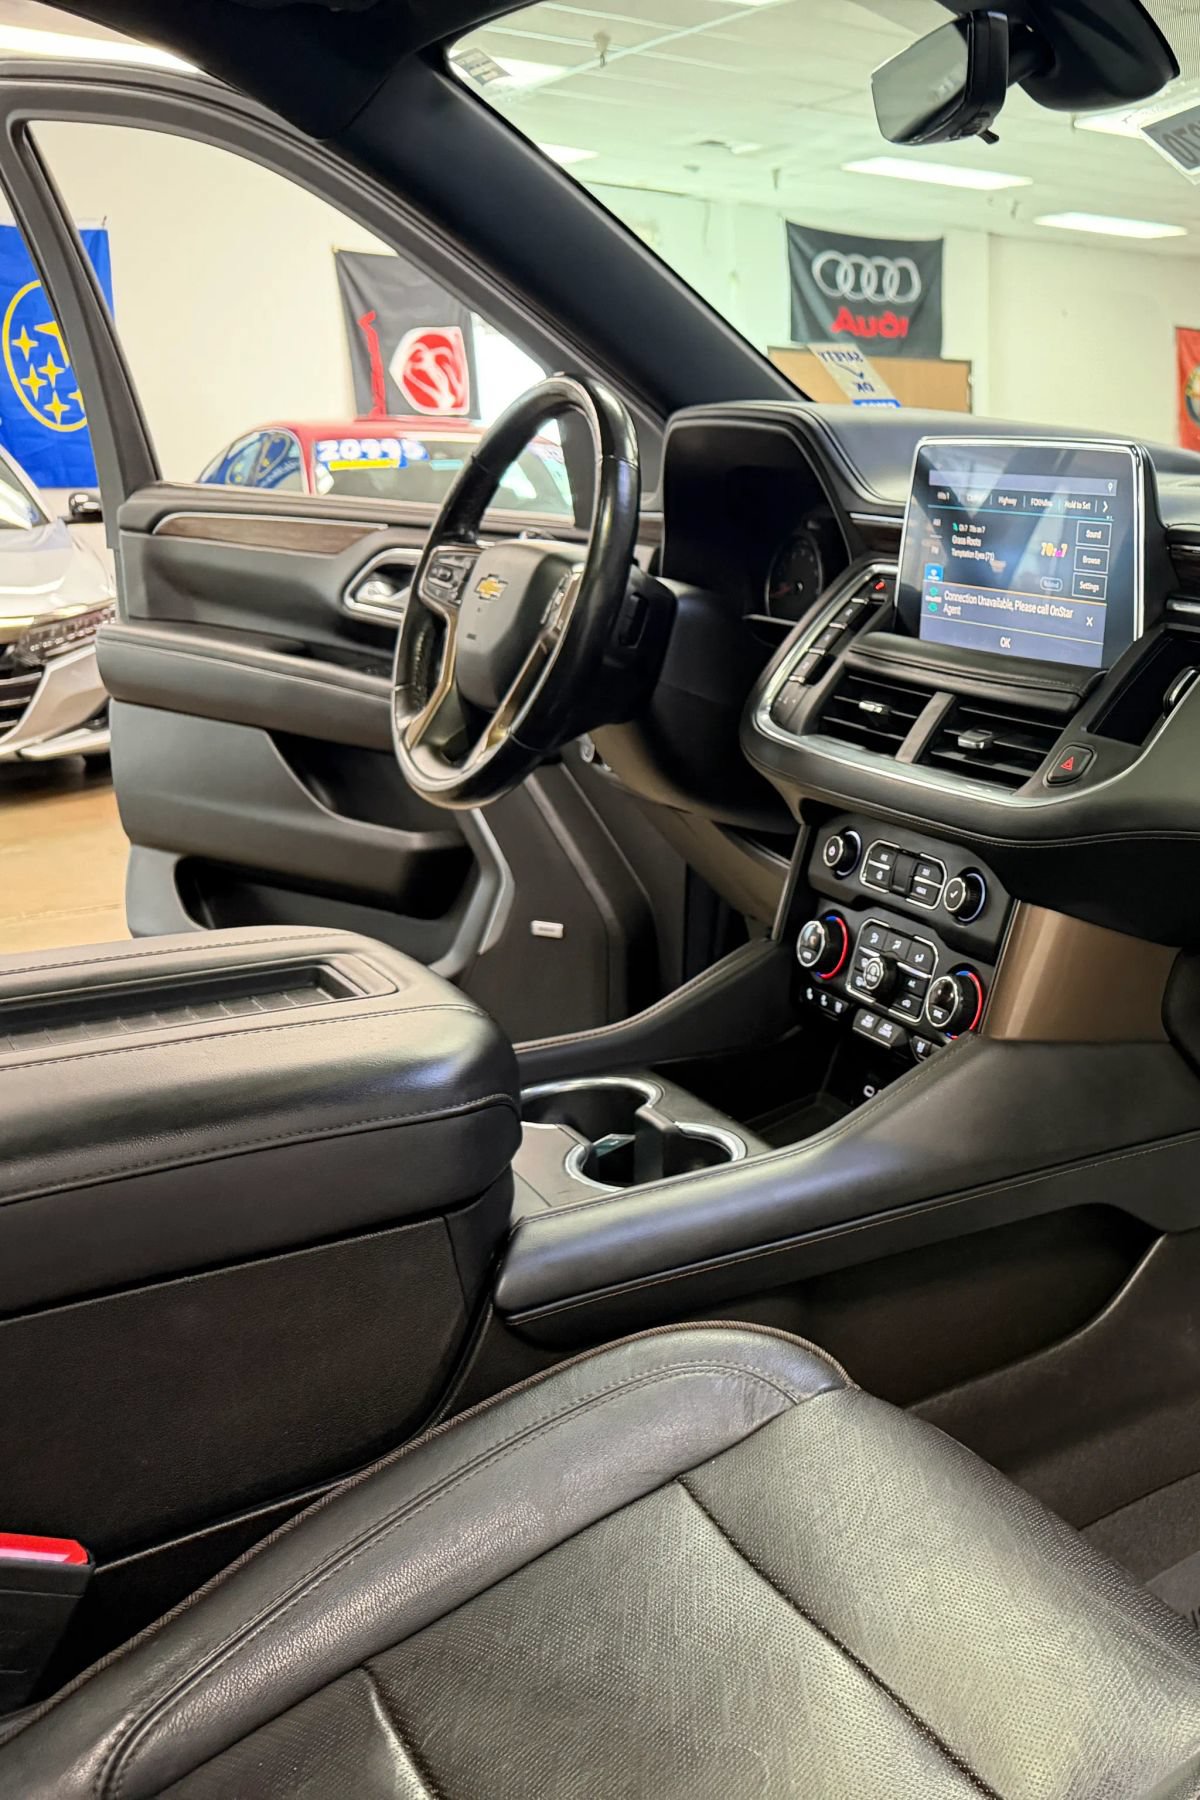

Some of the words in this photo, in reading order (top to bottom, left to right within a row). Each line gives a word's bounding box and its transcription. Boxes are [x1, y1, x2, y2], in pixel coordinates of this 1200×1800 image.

[831, 306, 909, 339] Audi
[1079, 581, 1099, 593] Settings
[943, 604, 961, 617] Agent
[944, 590, 977, 605] Connection
[1014, 600, 1036, 614] Please
[1037, 602, 1049, 615] call
[1050, 605, 1073, 619] OnStar
[1000, 637, 1010, 648] OK
